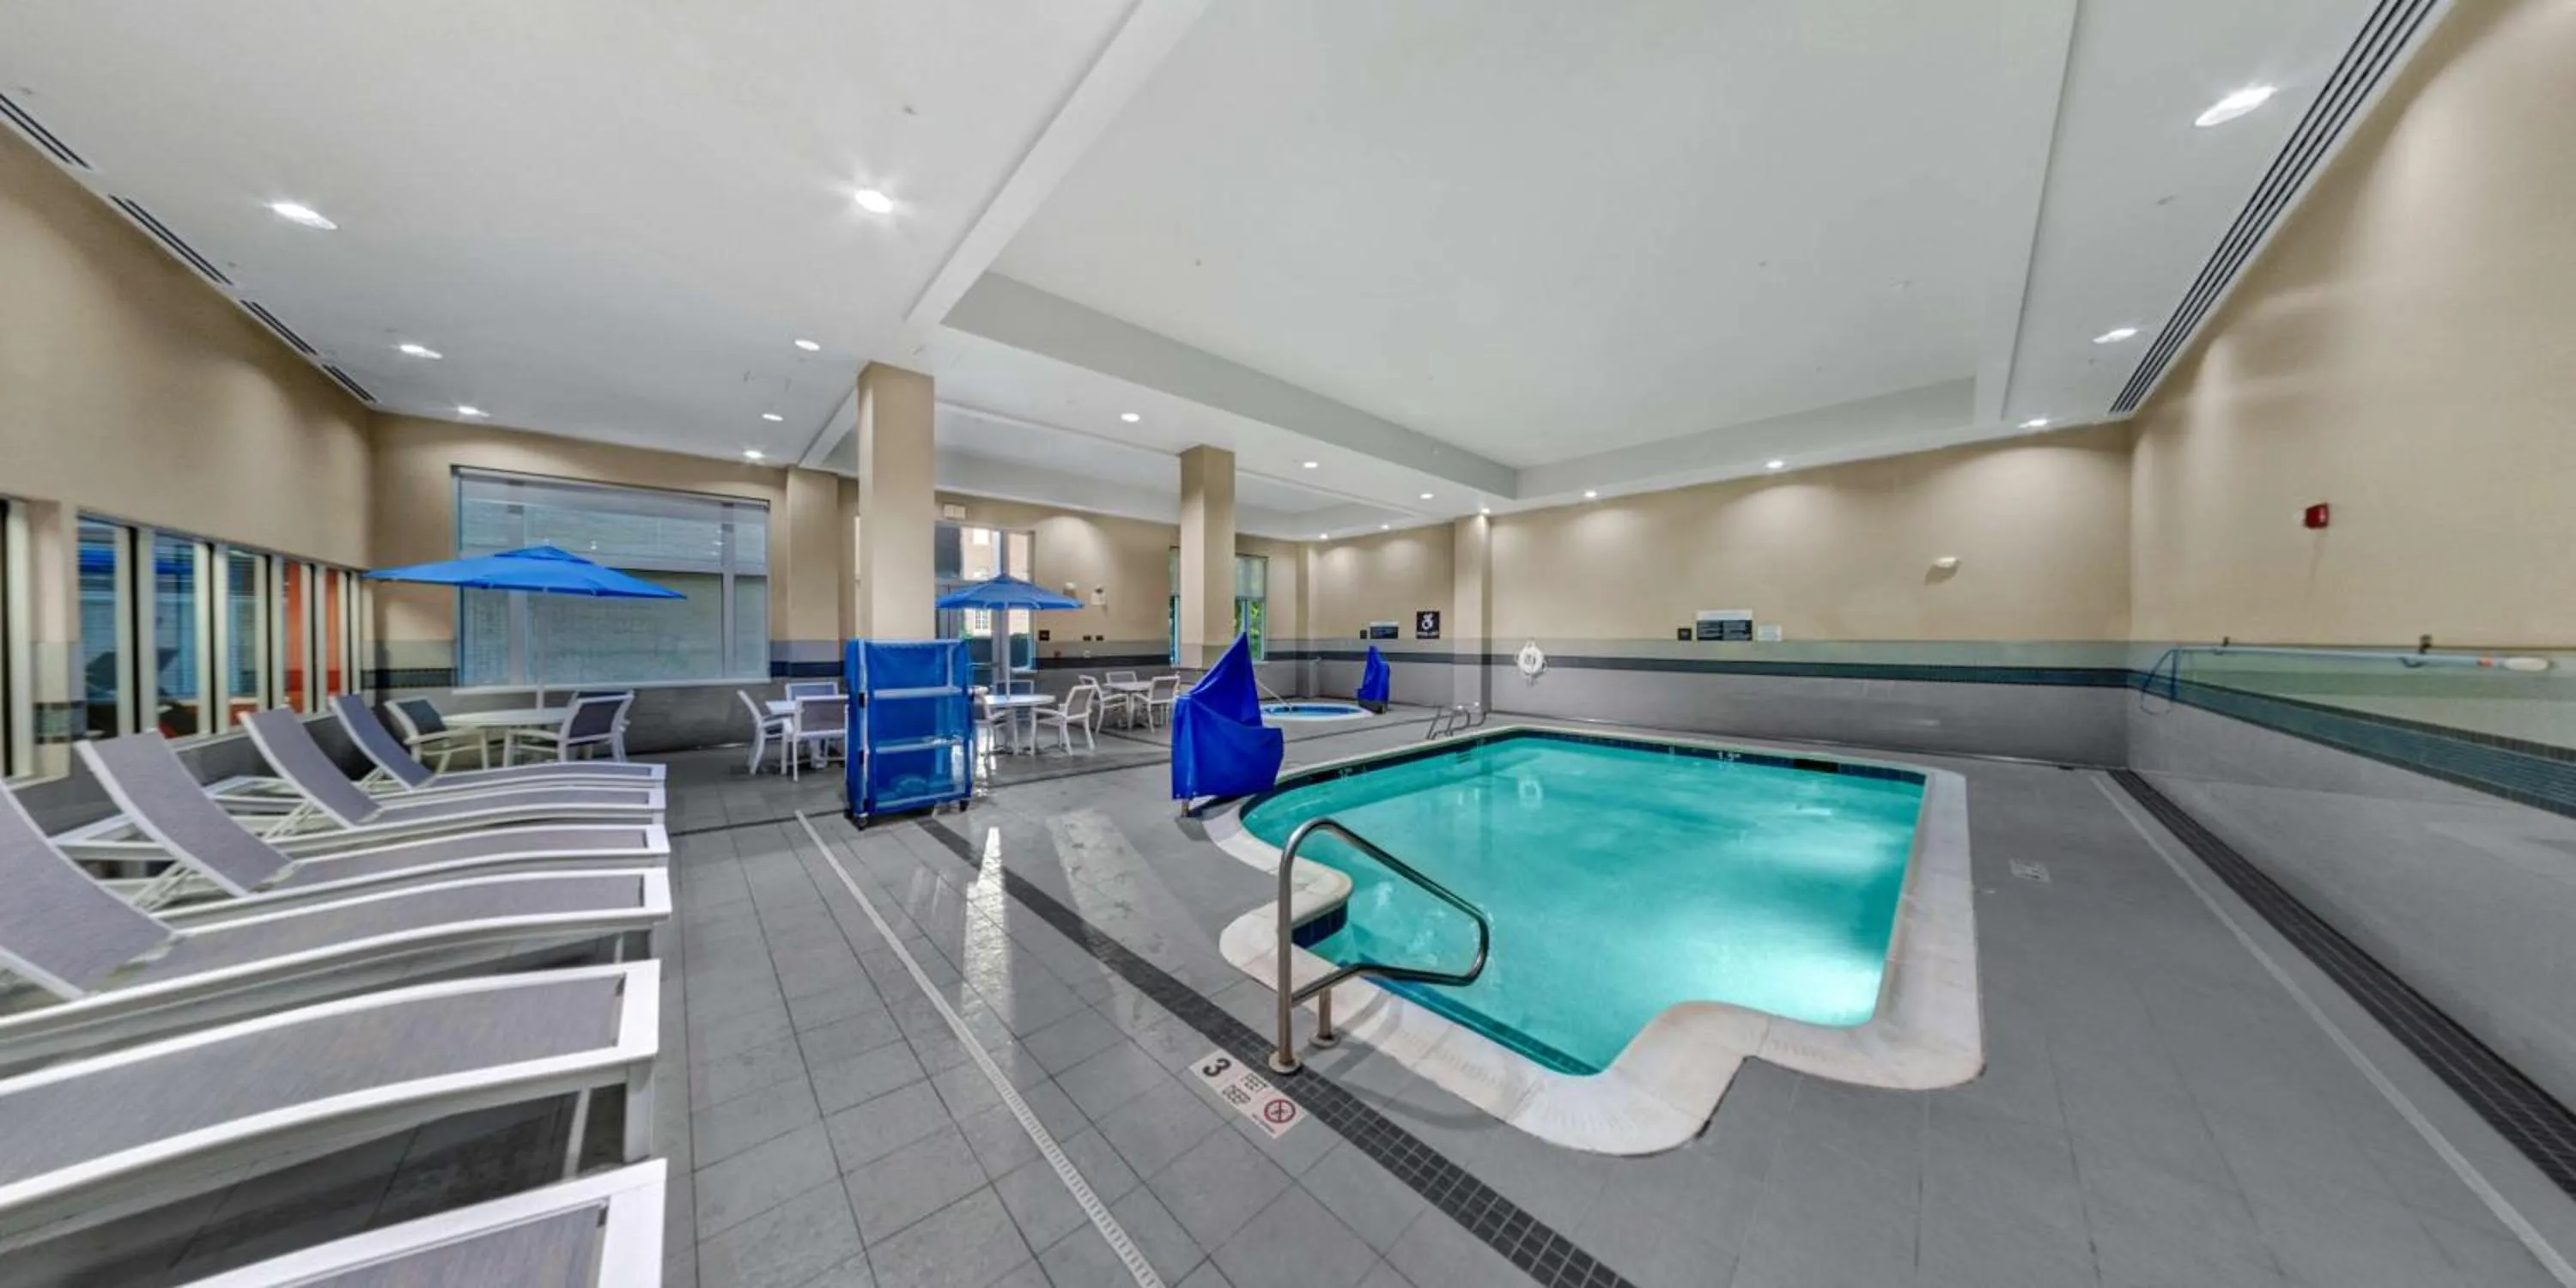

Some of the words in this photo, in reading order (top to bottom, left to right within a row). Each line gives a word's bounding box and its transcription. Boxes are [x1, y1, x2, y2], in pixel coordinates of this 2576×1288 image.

[1202, 1058, 1231, 1077] 3
[1240, 1072, 1267, 1093] FEET
[1222, 1084, 1251, 1105] DEEP
